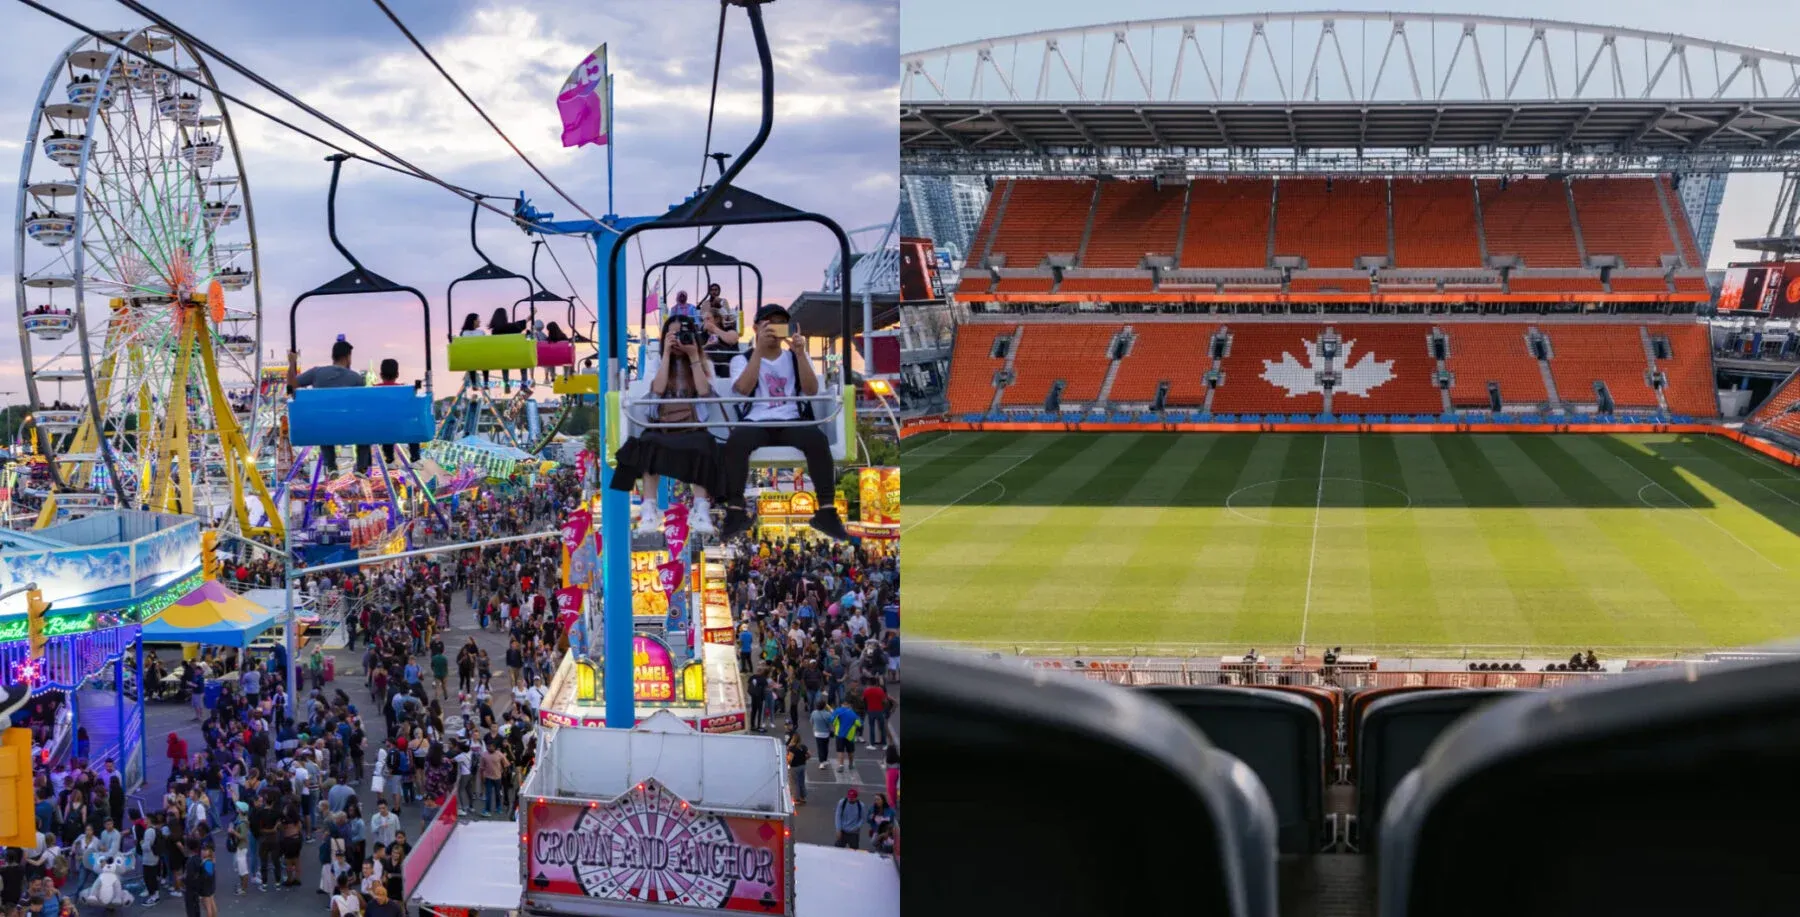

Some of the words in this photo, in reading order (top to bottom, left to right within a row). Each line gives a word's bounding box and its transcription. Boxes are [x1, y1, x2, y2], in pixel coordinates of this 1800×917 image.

[48, 612, 92, 634] Round
[633, 665, 670, 682] AMEL
[633, 682, 671, 699] PLES
[534, 825, 615, 868] CROWN
[618, 833, 669, 871] AND
[674, 837, 775, 887] ANCHOR
